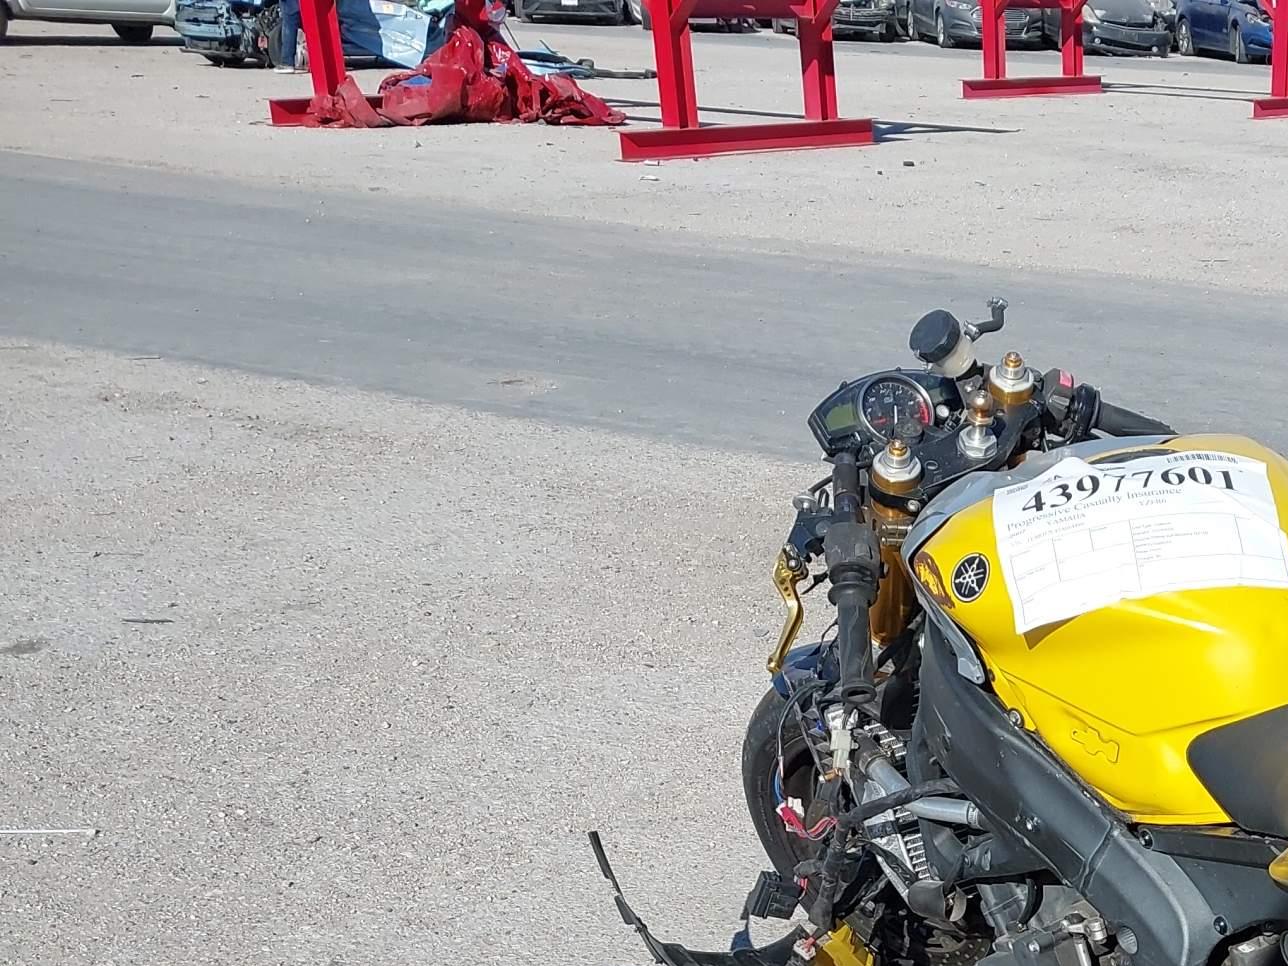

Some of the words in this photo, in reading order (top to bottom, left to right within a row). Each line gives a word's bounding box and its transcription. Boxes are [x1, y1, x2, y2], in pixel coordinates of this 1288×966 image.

[1007, 507, 1071, 532] Progressive
[1073, 494, 1122, 513] Casualty
[1126, 487, 1183, 500] Insurance
[1022, 466, 1237, 512] 43977601
